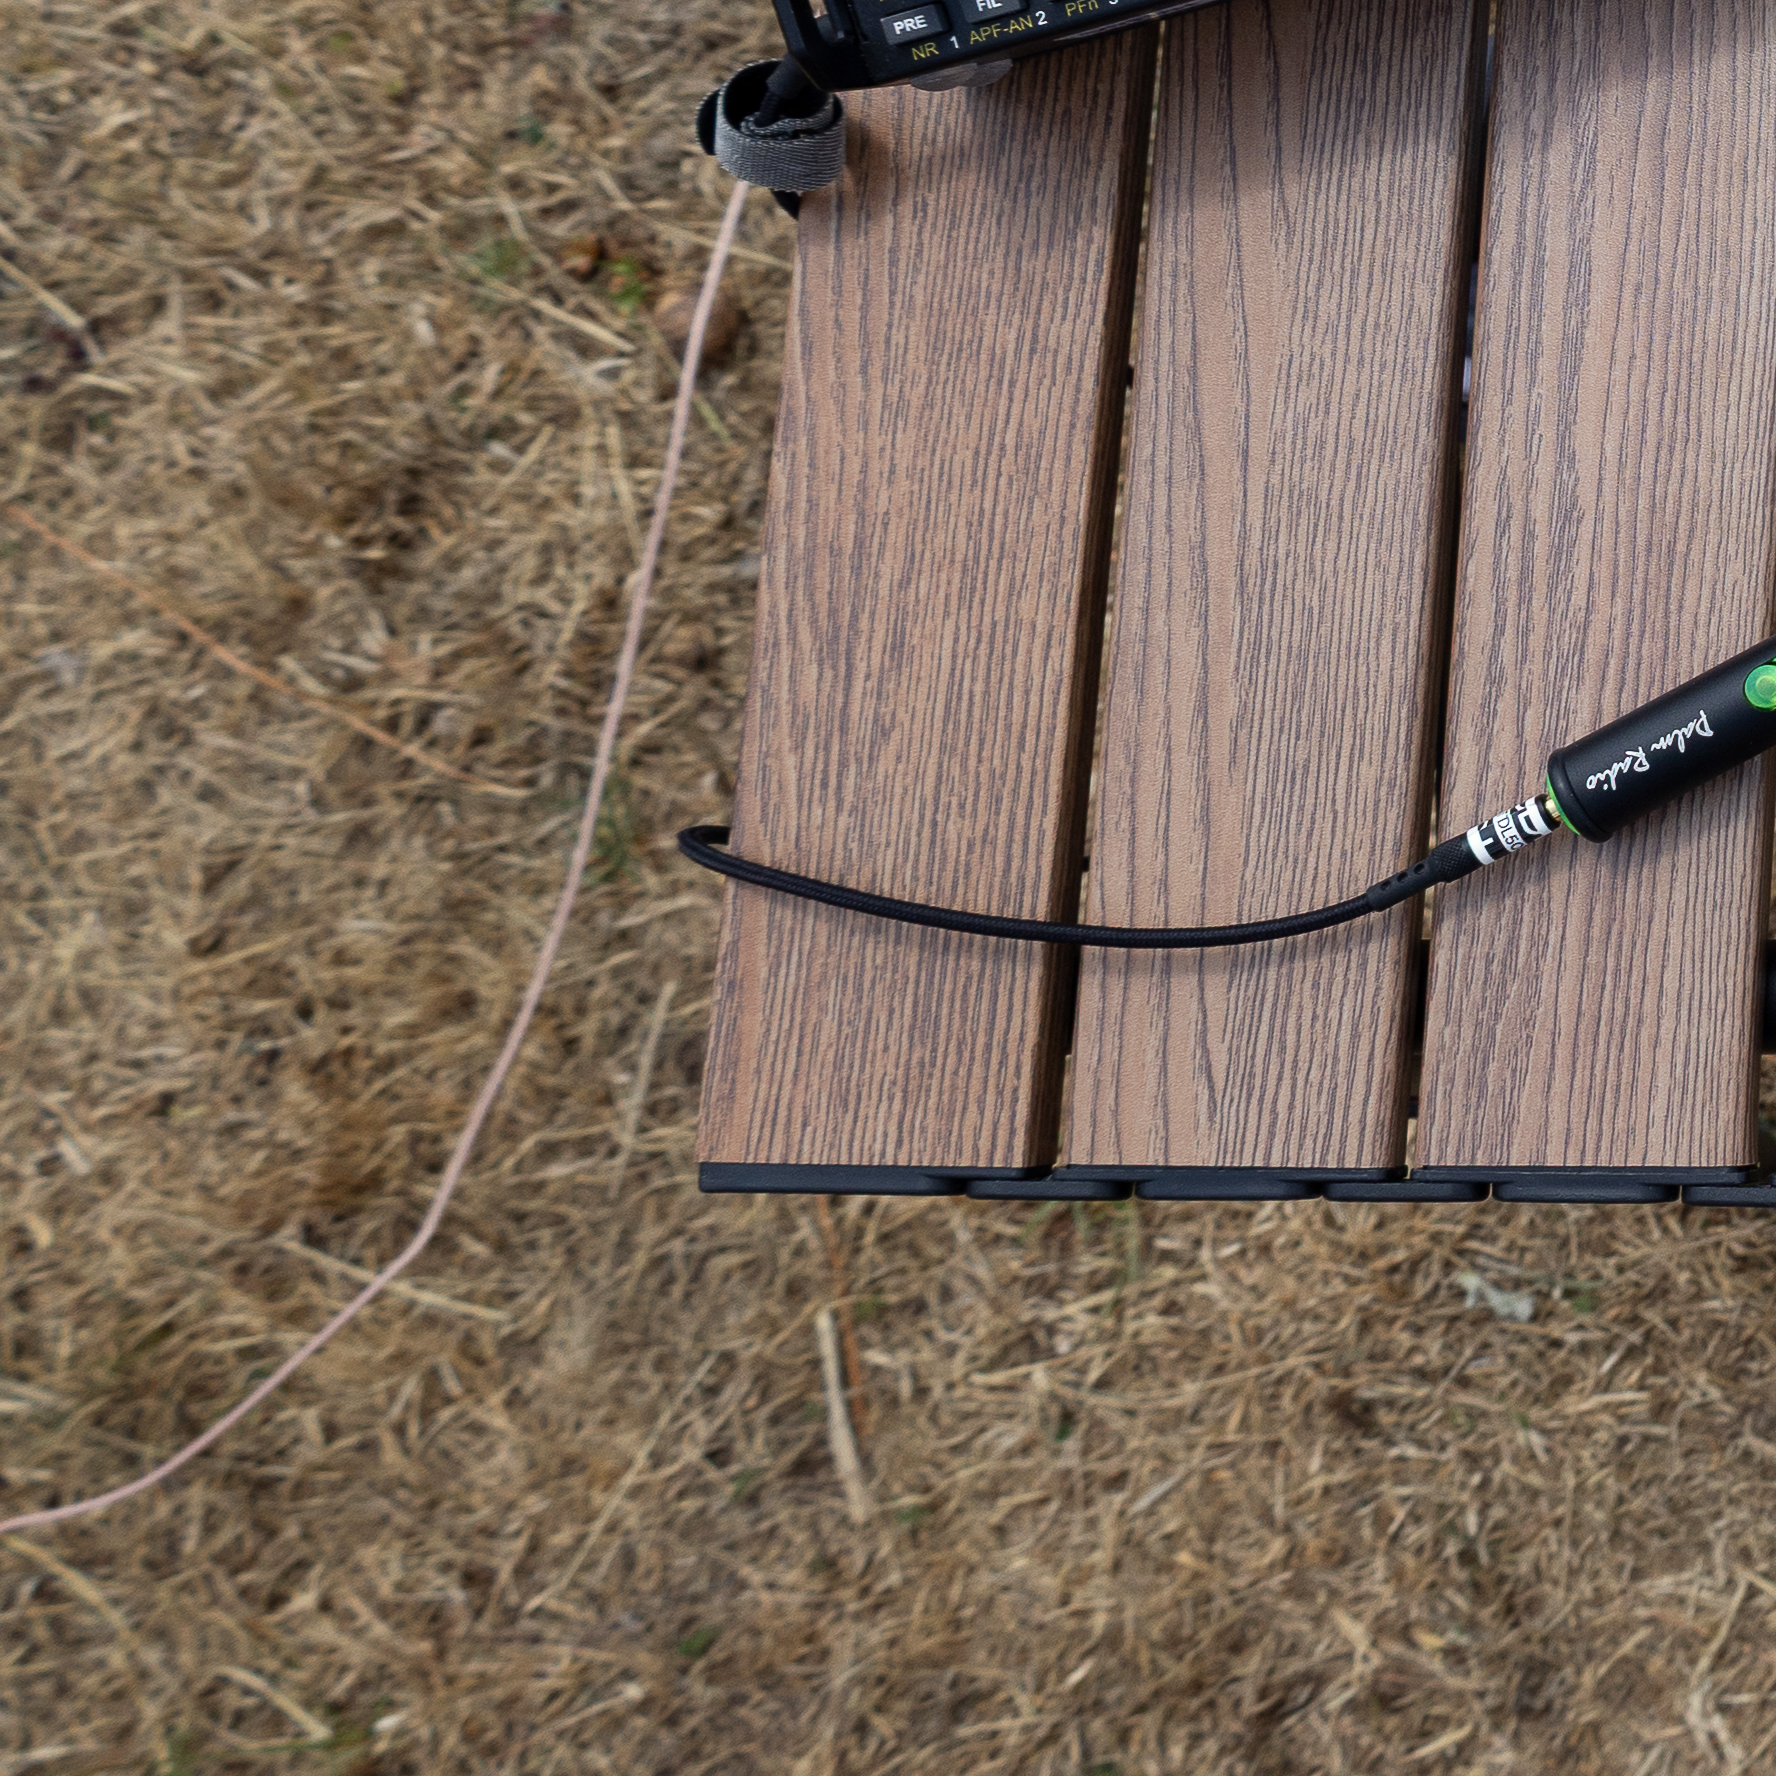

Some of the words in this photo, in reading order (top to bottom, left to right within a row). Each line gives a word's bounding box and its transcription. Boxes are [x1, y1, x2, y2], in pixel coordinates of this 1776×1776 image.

[893, 14, 929, 36] PRE
[969, 14, 1034, 45] APF-AN
[1034, 9, 1049, 26] 2
[910, 41, 940, 62] NR
[949, 34, 961, 50] 1
[1649, 708, 1715, 755] Palm
[1585, 744, 1650, 791] Radio
